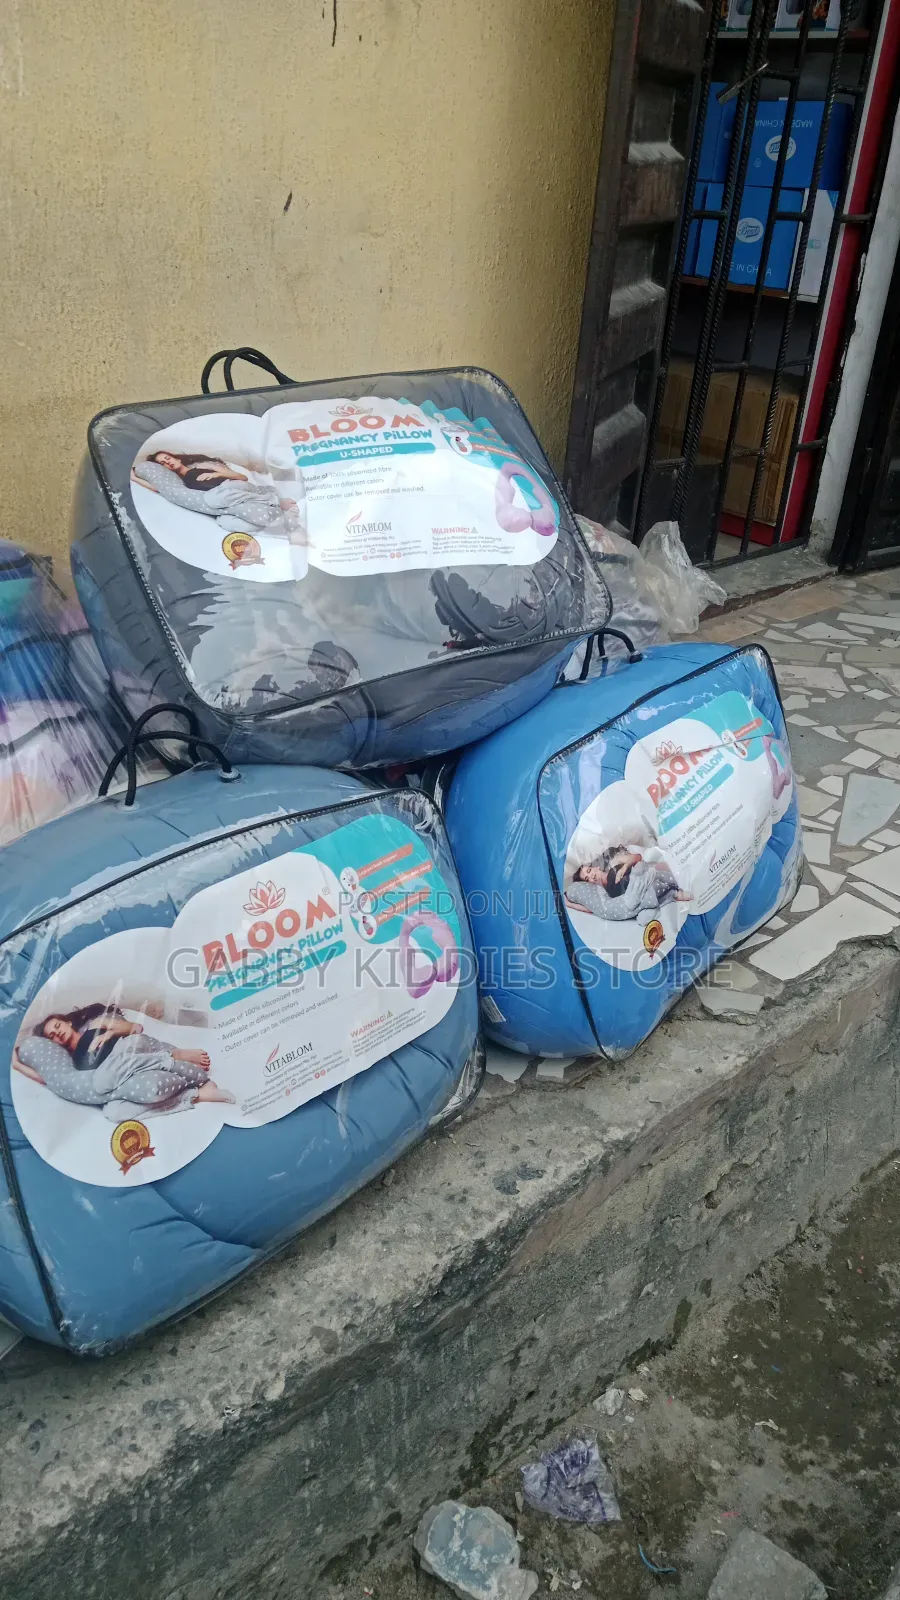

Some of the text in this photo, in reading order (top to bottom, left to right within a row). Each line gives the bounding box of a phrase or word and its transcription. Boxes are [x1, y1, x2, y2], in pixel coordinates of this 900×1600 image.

[736, 263, 745, 271] IN
[746, 264, 772, 277] CHA
[287, 415, 425, 443] BLOOM
[291, 433, 378, 456] PREGNANCY
[340, 445, 393, 458] U-SHAPED
[345, 522, 392, 534] VITABLOM
[202, 894, 337, 970] BLOOM
[217, 1016, 236, 1029] Made
[291, 985, 306, 995] fibre
[221, 1025, 248, 1041] Available
[256, 1009, 281, 1024] different
[281, 1000, 300, 1012] colors
[224, 1040, 243, 1052] Outer
[243, 1032, 260, 1043] cover
[260, 1026, 271, 1035] can
[271, 1020, 279, 1029] be
[279, 1008, 306, 1024] removed
[305, 1003, 317, 1013] and
[350, 1013, 387, 1038] WARNING!
[265, 1041, 314, 1075] VITABLOM
